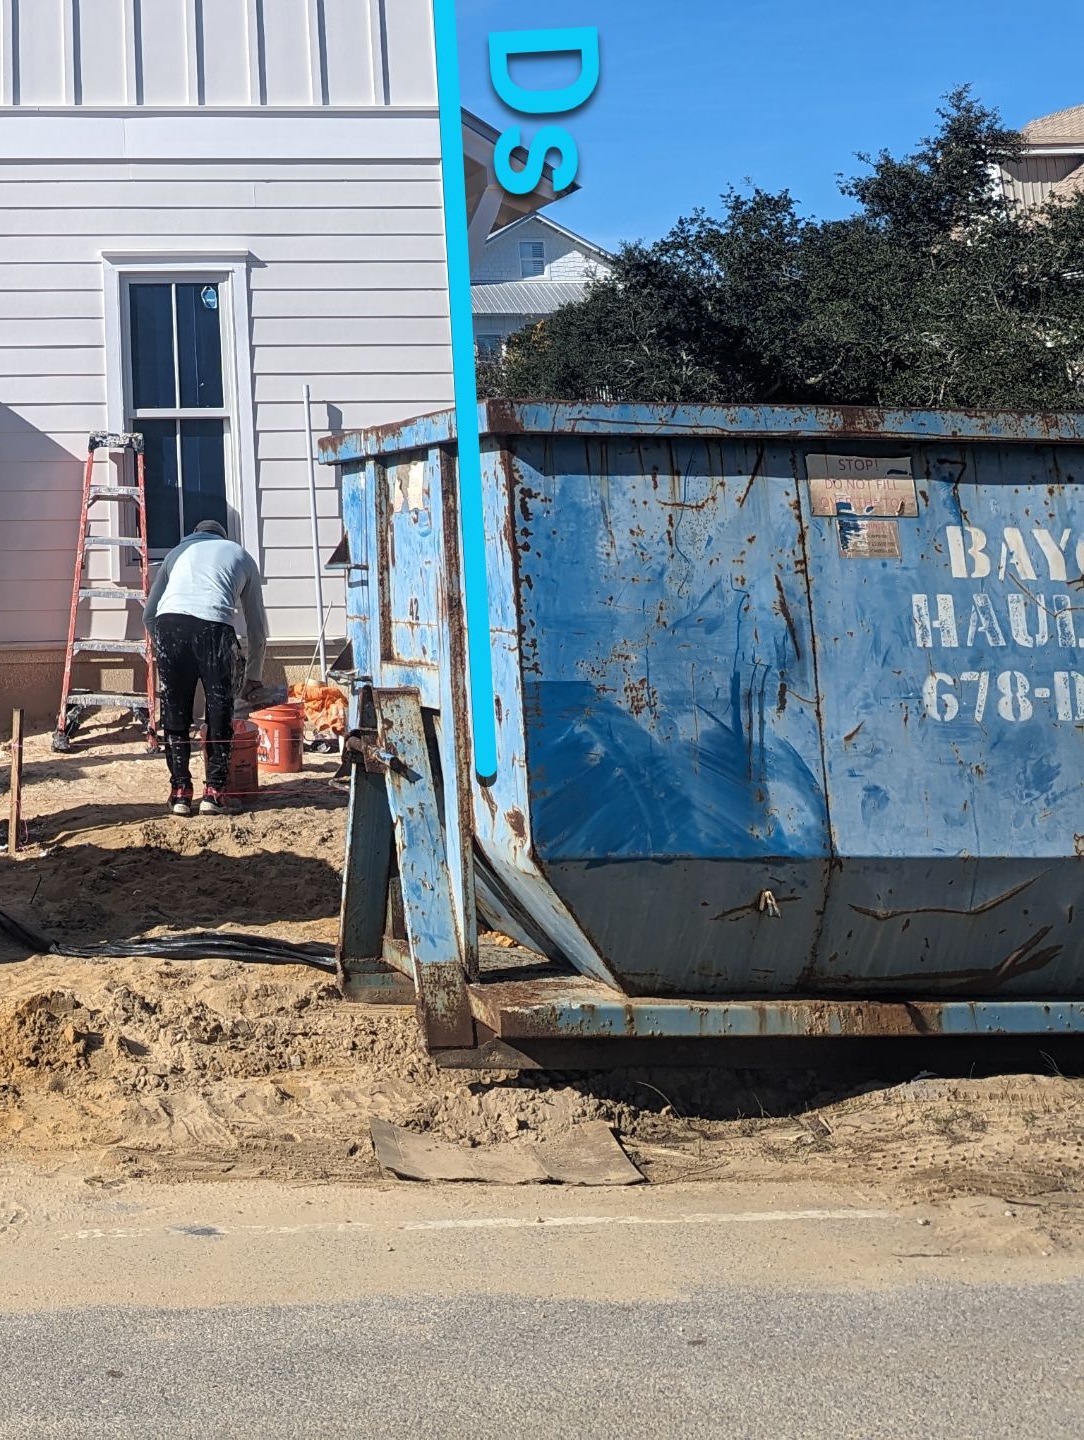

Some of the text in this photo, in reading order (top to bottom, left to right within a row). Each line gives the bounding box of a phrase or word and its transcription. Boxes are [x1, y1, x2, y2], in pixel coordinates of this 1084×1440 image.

[838, 459, 879, 471] STOP!
[824, 480, 899, 490] DO NOT FILL
[946, 525, 1084, 582] BAY
[409, 597, 420, 621] 42
